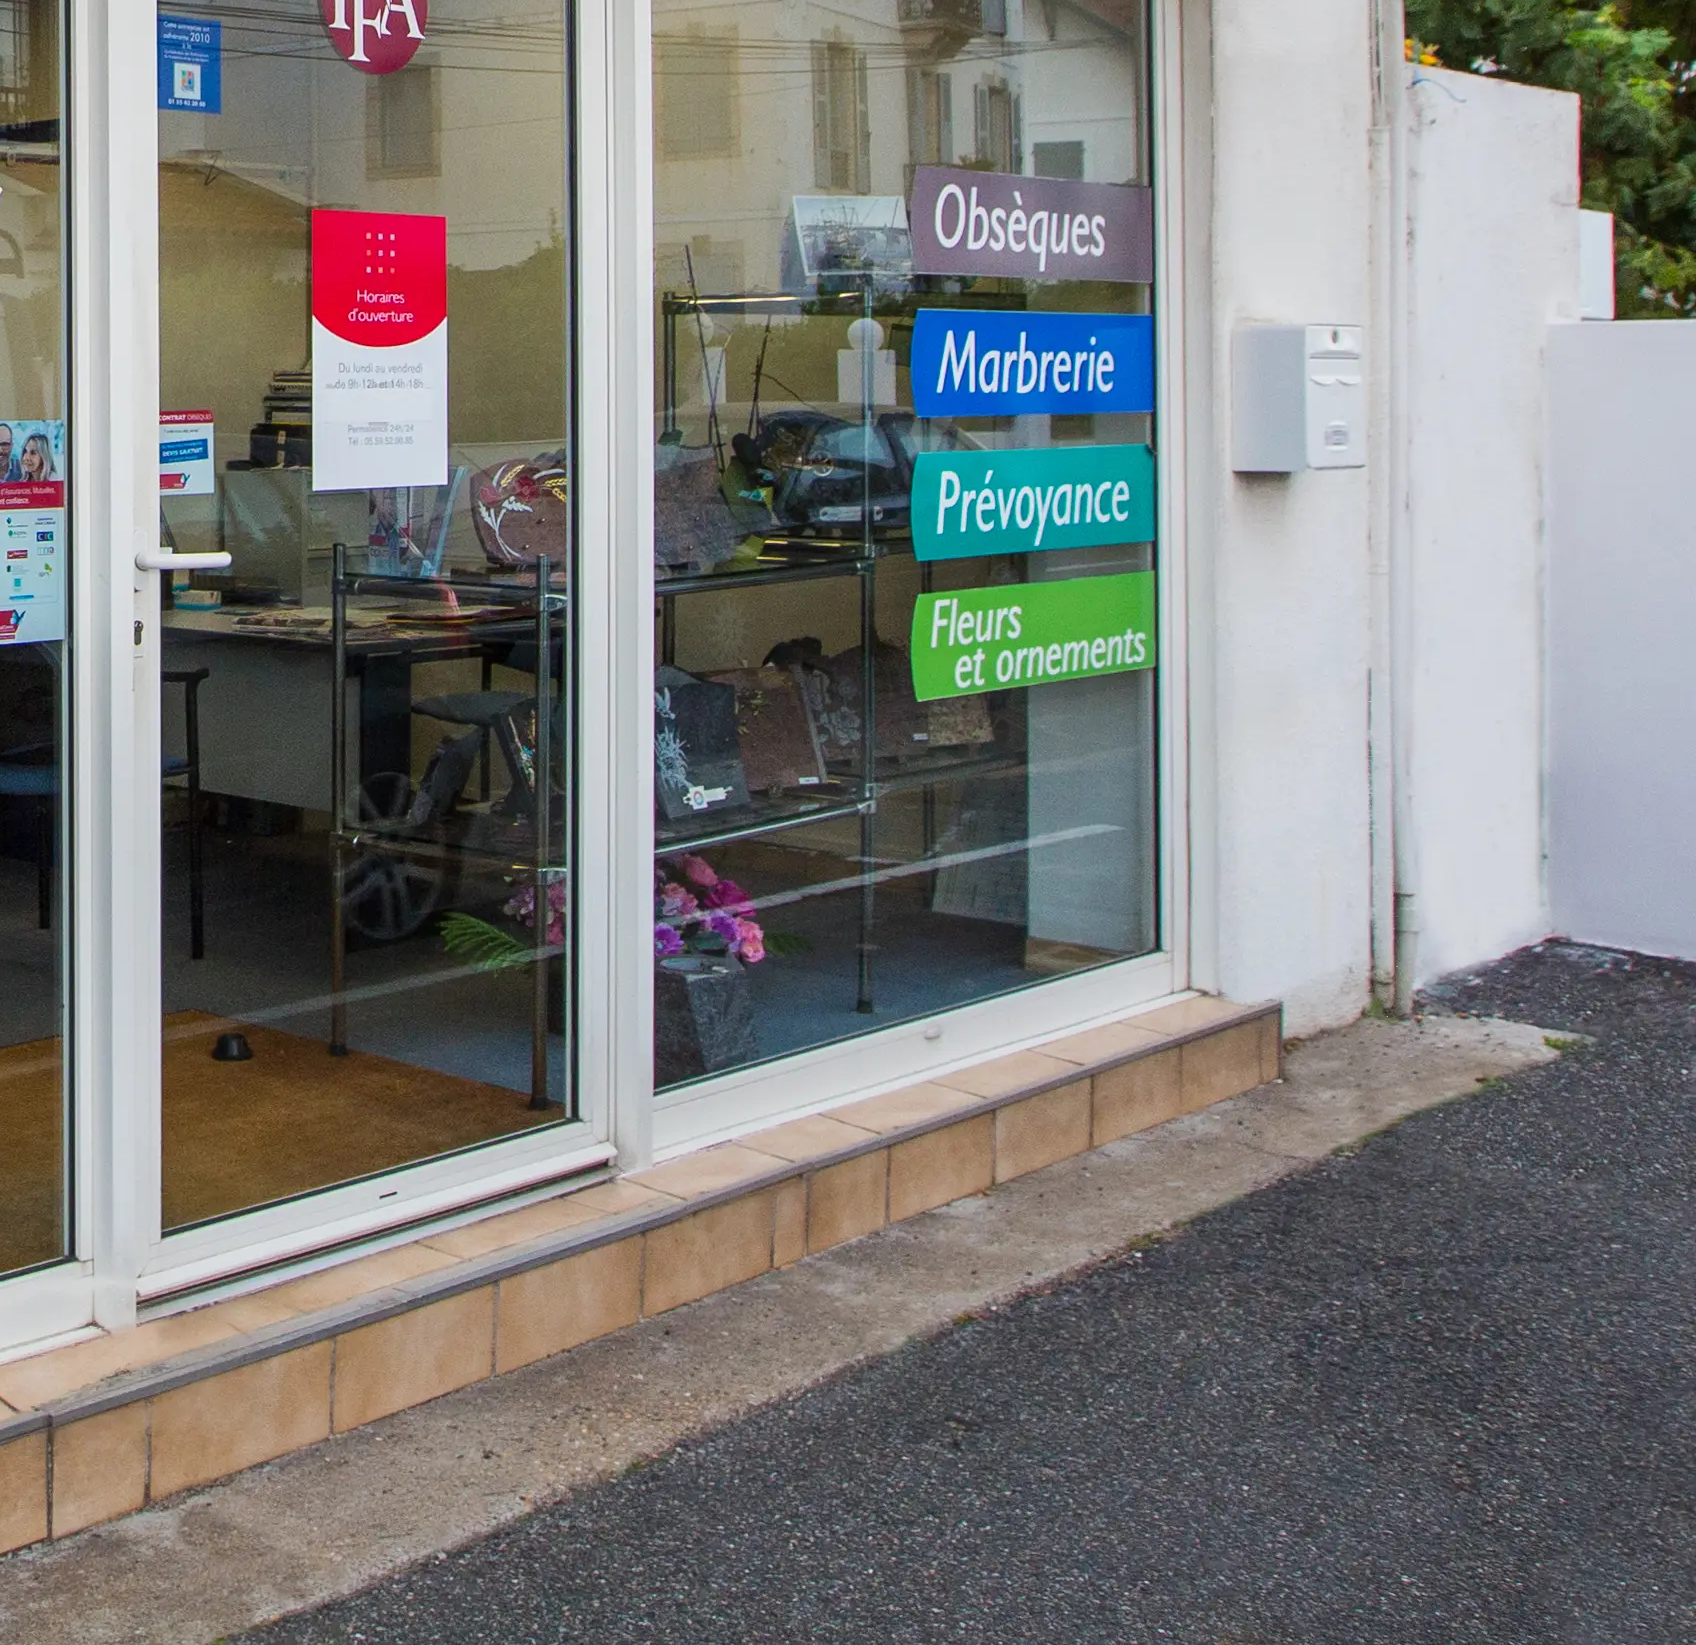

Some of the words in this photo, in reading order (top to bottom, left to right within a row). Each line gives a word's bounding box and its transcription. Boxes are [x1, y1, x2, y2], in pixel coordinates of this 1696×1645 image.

[190, 32, 210, 43] 2010
[934, 183, 1106, 272] Obsèques
[356, 289, 405, 304] Horaires
[348, 308, 414, 323] d'ouverture
[338, 362, 350, 373] Du
[352, 362, 373, 373] lundi
[375, 364, 385, 373] au
[388, 362, 424, 374] vendredi
[936, 330, 1115, 394] Marbrerie
[335, 379, 345, 389] de
[937, 470, 1130, 546] Prévoyance
[930, 599, 1022, 649] Fleurs
[954, 651, 985, 689] et
[996, 628, 1147, 682] ornements
